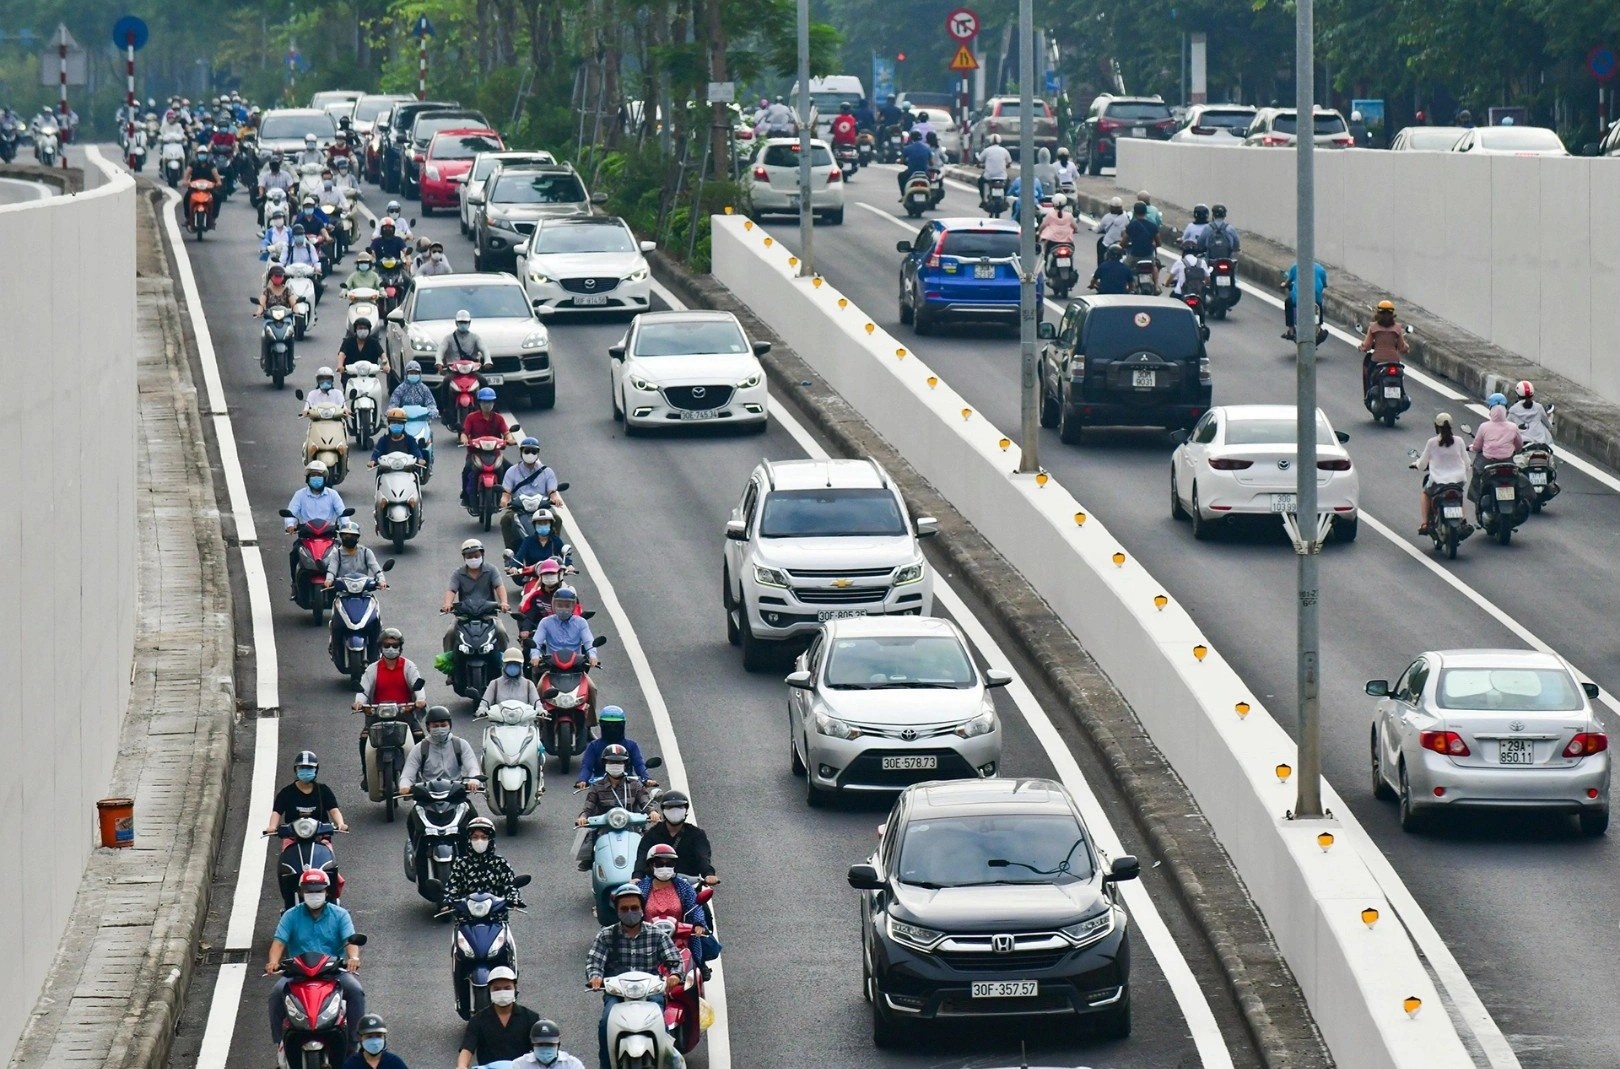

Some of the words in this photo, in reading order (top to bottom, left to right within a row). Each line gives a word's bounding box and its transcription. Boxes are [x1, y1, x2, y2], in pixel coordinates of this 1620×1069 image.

[1507, 740, 1526, 752] 29A
[883, 756, 936, 769] 30E-578.73
[1500, 752, 1532, 763] 850.11
[973, 982, 1036, 997] 30F-357.57
